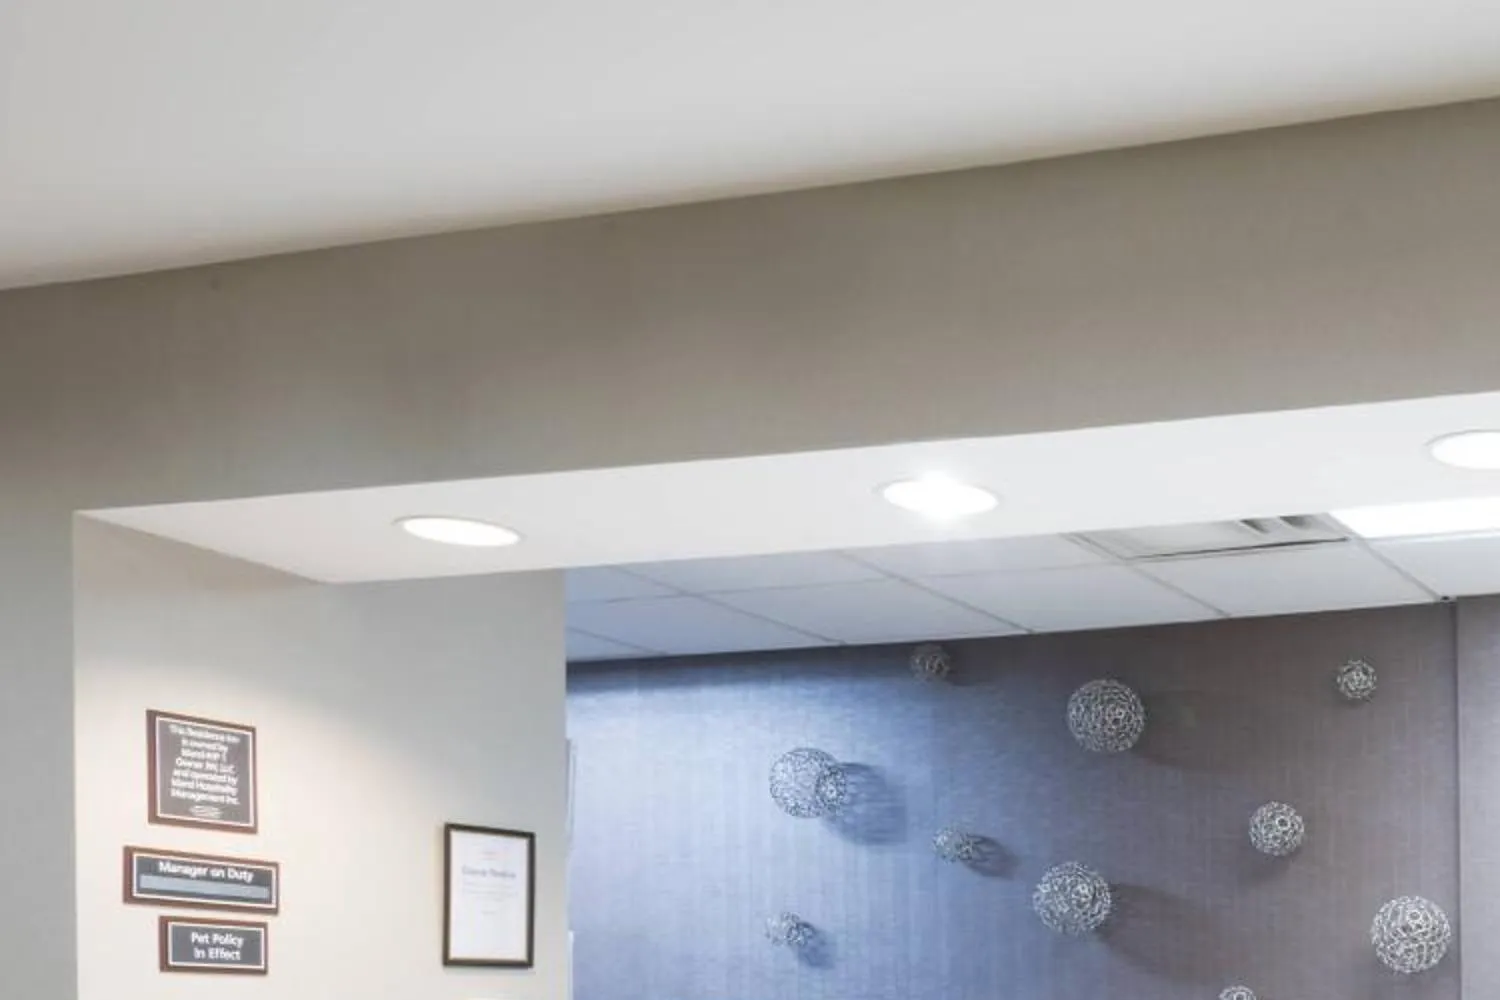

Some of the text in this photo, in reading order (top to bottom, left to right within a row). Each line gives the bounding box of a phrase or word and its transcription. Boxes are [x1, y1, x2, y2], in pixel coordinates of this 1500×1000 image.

[175, 756, 203, 769] Owner
[170, 787, 225, 803] Management
[158, 860, 254, 883] Manager on Duty
[191, 931, 245, 949] Pet Policy
[208, 947, 241, 961] Effect
